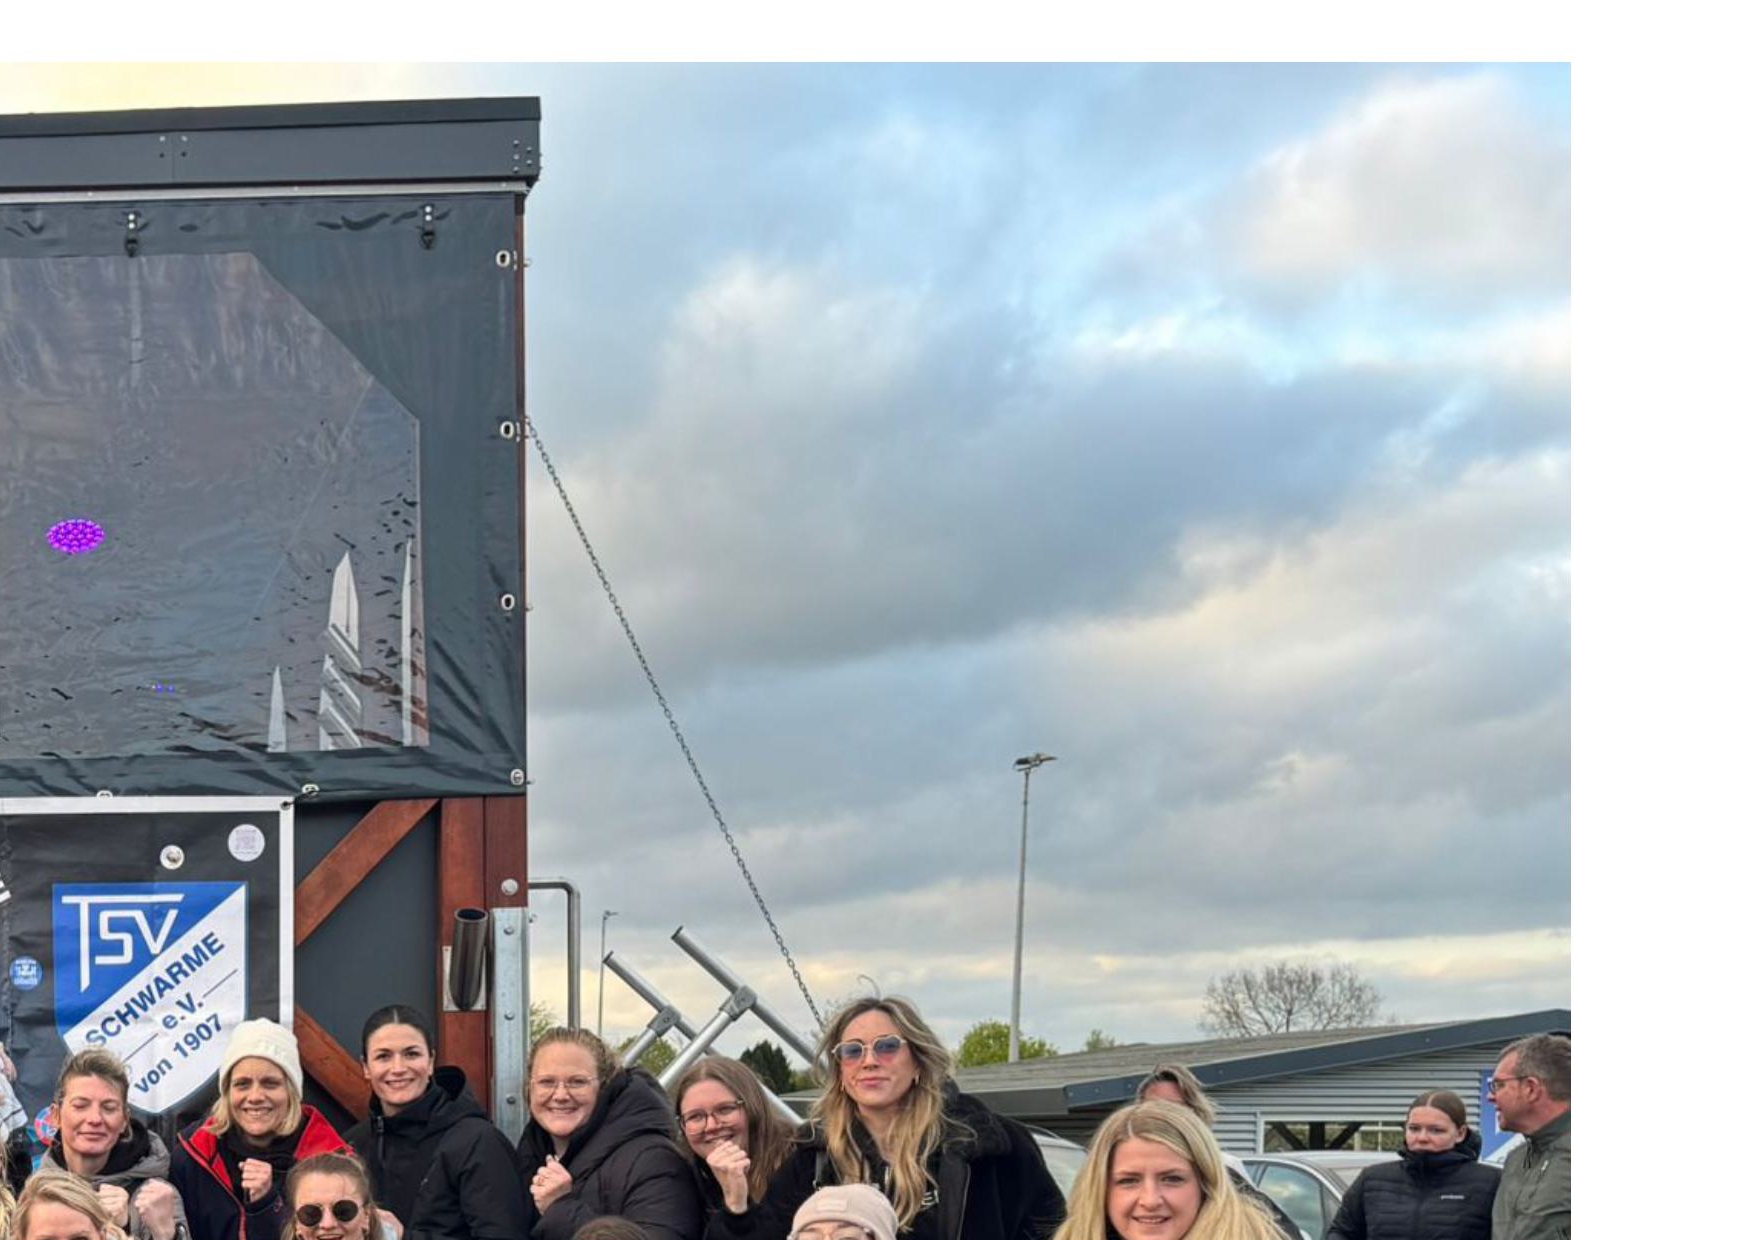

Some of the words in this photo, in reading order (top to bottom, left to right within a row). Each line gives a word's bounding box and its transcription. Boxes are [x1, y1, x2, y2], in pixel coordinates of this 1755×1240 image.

[62, 893, 185, 993] TSV
[85, 931, 226, 1047] SCHWARME
[162, 992, 204, 1030] e.V.
[134, 1057, 173, 1094] von
[173, 1012, 223, 1058] 1907
